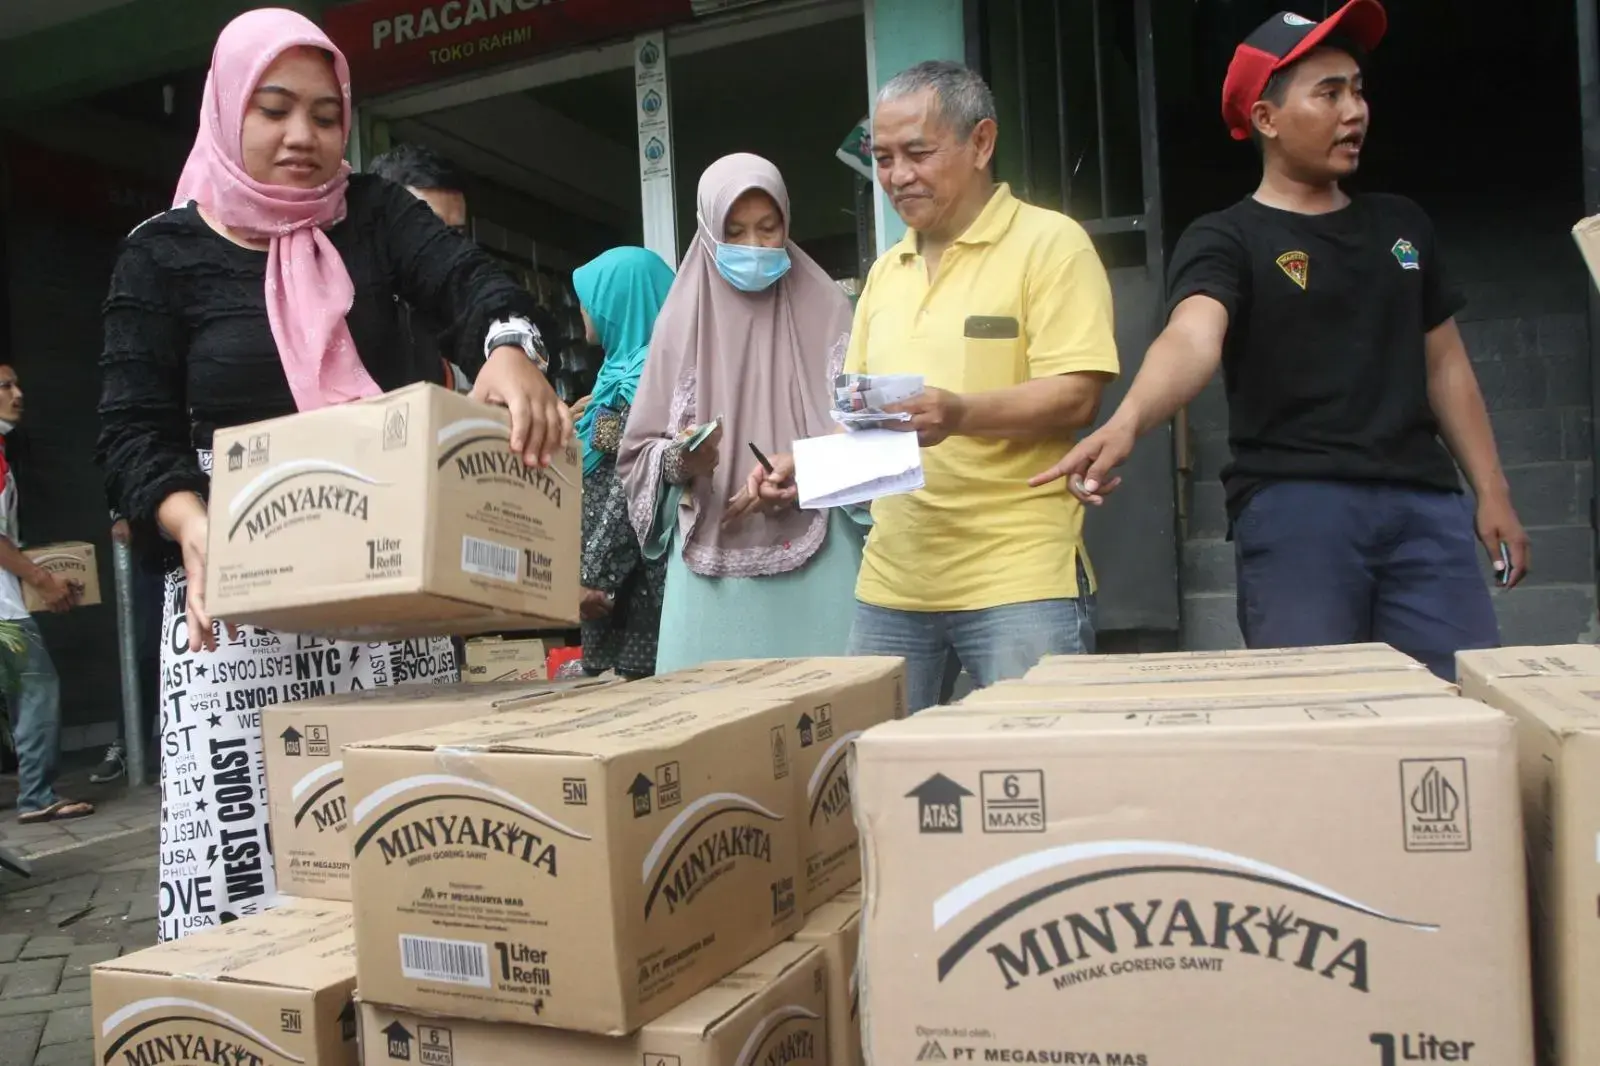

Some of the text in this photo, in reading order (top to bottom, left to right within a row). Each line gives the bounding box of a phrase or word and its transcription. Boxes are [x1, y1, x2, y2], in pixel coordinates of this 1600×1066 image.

[372, 0, 566, 49] PRACAN
[429, 25, 532, 65] TOKO RAHMI
[455, 450, 562, 509] MINYAKITA
[245, 485, 369, 541] MINYAKITA
[366, 540, 375, 569] 1
[525, 548, 533, 577] 1
[250, 636, 281, 647] USA
[212, 655, 293, 684] EAST COAST
[295, 647, 342, 681] NYC
[400, 655, 437, 681] COAS
[437, 651, 456, 672] EST
[165, 659, 194, 689] AST
[190, 699, 221, 712] USA
[225, 679, 326, 712] WEST COAST
[238, 712, 260, 729] WE
[820, 708, 826, 721] 6
[313, 728, 321, 740] 6
[176, 761, 197, 776] USA
[664, 767, 672, 784] 6
[173, 774, 206, 797] ATL
[563, 781, 588, 802] SNI
[1003, 774, 1021, 800] 6
[208, 738, 265, 904] WEST COAST
[922, 803, 959, 828] ATAS
[988, 811, 1042, 828] MAKS
[172, 819, 213, 843] WEST
[1412, 824, 1461, 834] HALAL
[162, 848, 196, 866] USA
[376, 814, 558, 877] MINYAKITA
[162, 865, 199, 879] PHILLY
[313, 861, 350, 870] MEGASURY
[662, 824, 772, 915] MINYAKITA
[160, 875, 216, 918] OVE
[183, 915, 214, 928] USA
[511, 943, 548, 965] Liter
[987, 899, 1370, 993] MINYAKITA
[494, 941, 511, 981] 1
[513, 966, 551, 986] Refill
[1053, 956, 1224, 991] MINYAK GORENG SAWIT
[281, 1013, 302, 1030] SNI
[430, 1029, 439, 1045] 6
[1402, 1032, 1476, 1062] Liter
[389, 1040, 409, 1058] ATAS
[422, 1051, 451, 1065] MAKS
[952, 1047, 1147, 1066] PT MEGASURYA MAS
[1368, 1032, 1396, 1066] 1
